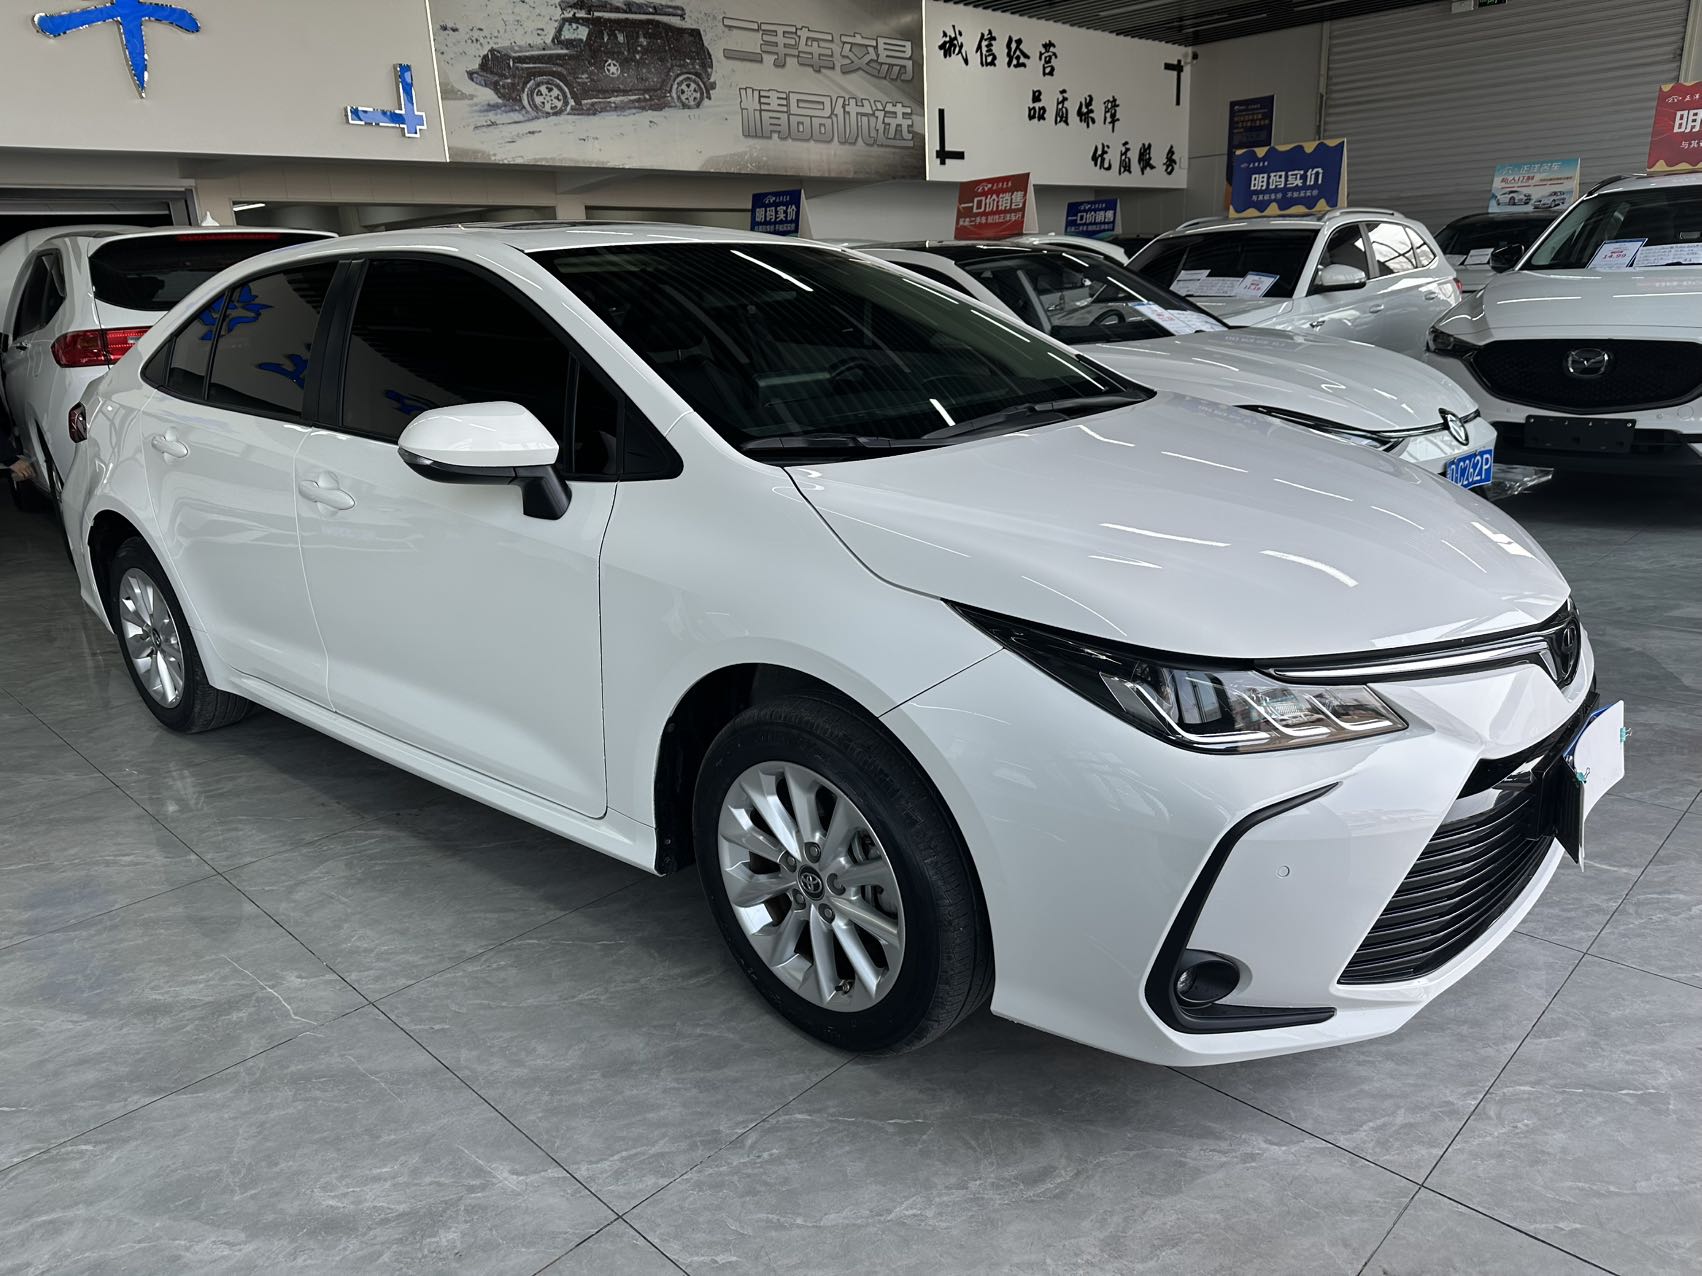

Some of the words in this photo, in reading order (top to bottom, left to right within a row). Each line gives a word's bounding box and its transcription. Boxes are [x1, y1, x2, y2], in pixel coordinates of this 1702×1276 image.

[722, 16, 914, 81] 二手车交易
[938, 25, 1058, 77] 诚信经营
[739, 87, 914, 147] 精品优选
[1028, 89, 1120, 133] 品质保障
[1091, 141, 1177, 175] 优质服务
[1680, 140, 1702, 150] 与其
[1250, 167, 1323, 190] 明码实价
[755, 204, 797, 222] 明码实价
[960, 191, 1025, 213] 一口价销售
[1068, 210, 1114, 224] 一口价销售
